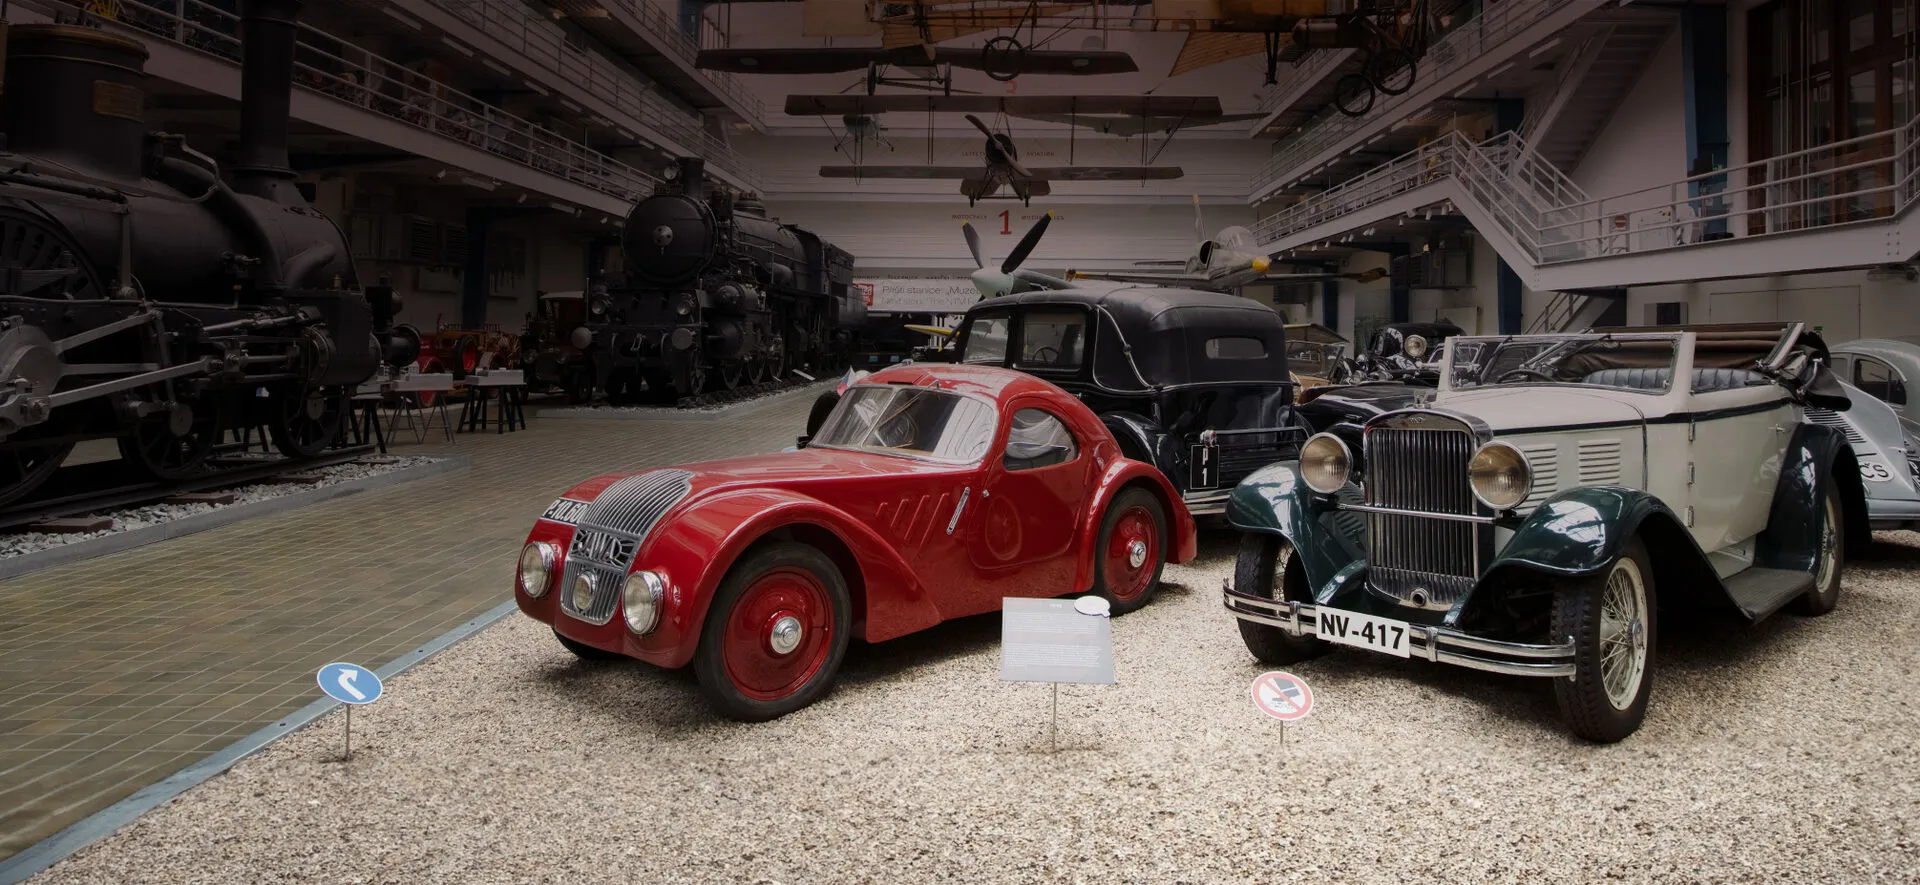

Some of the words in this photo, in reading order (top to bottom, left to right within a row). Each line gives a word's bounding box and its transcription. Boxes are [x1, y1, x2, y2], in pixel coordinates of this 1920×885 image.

[999, 210, 1012, 235] 1
[1203, 447, 1208, 465] P
[1202, 468, 1207, 486] 1
[1321, 613, 1404, 649] NV-417
